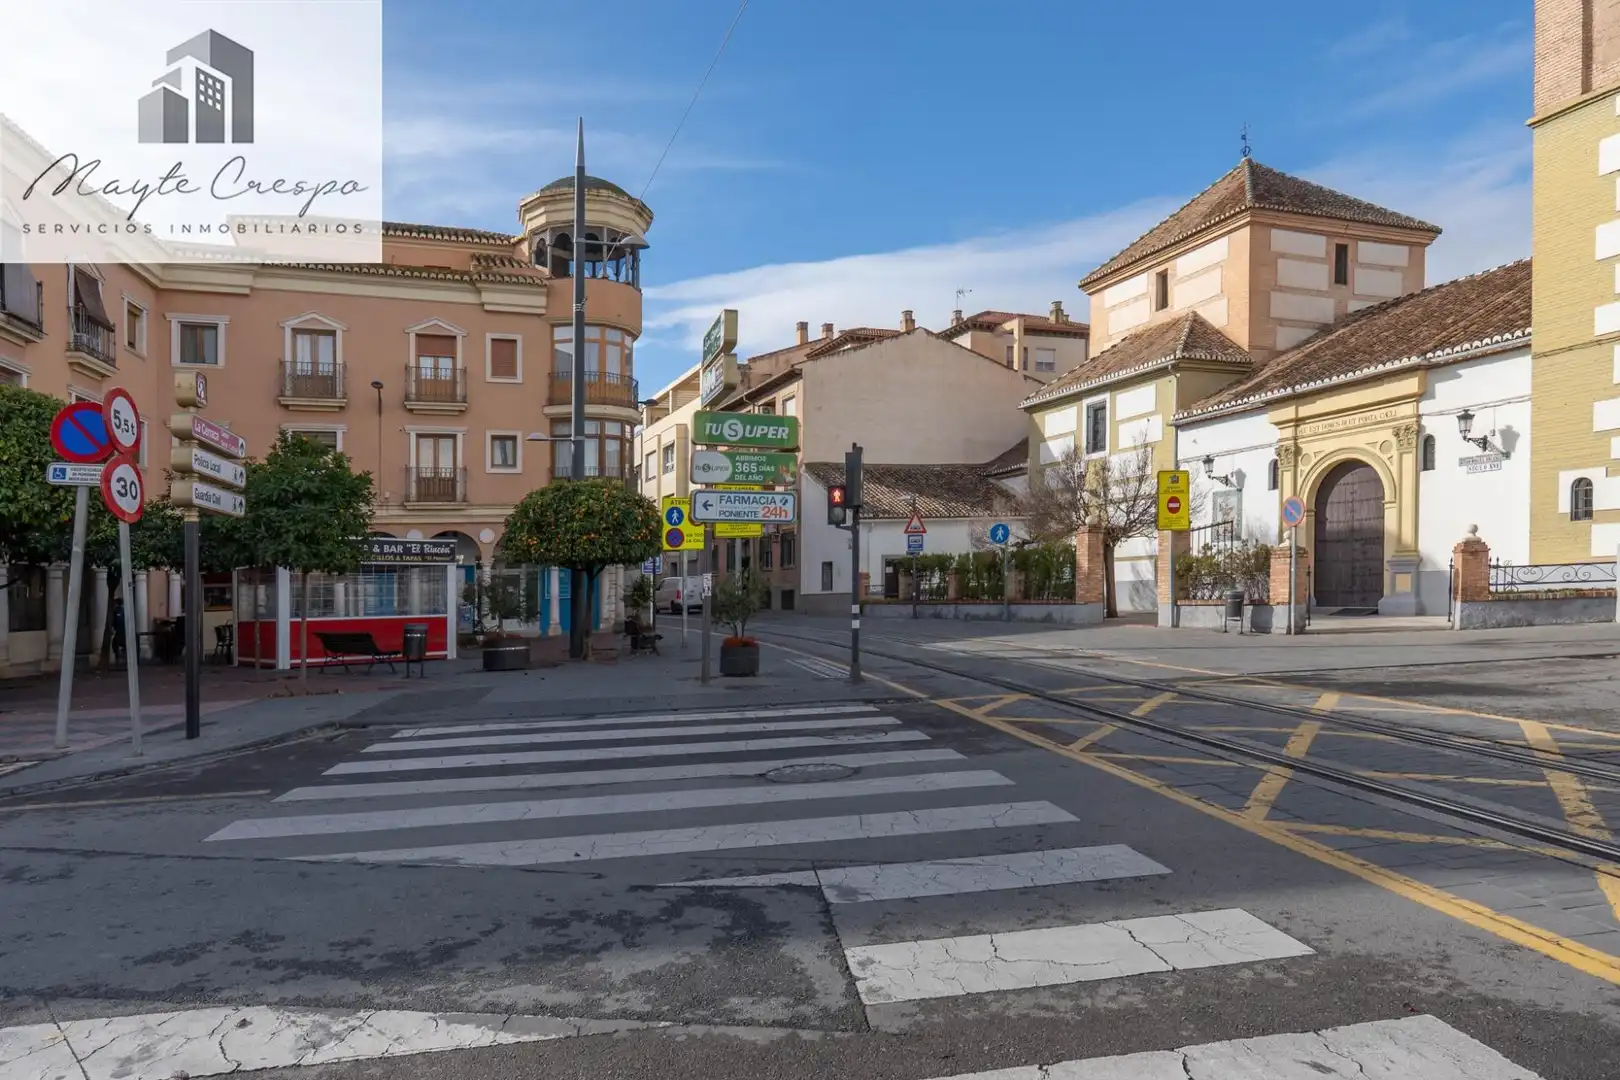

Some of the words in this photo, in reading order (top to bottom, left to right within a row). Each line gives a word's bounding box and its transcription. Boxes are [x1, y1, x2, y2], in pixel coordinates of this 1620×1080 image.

[705, 422, 722, 437] TU
[725, 421, 789, 440] SUPER
[209, 460, 221, 474] Local
[735, 462, 757, 473] 365
[748, 473, 764, 481] AÑO
[116, 477, 138, 501] 30
[719, 495, 777, 505] FARMACIA
[719, 509, 759, 518] PONIENTE
[762, 506, 789, 519] 24h
[383, 544, 403, 553] BAR
